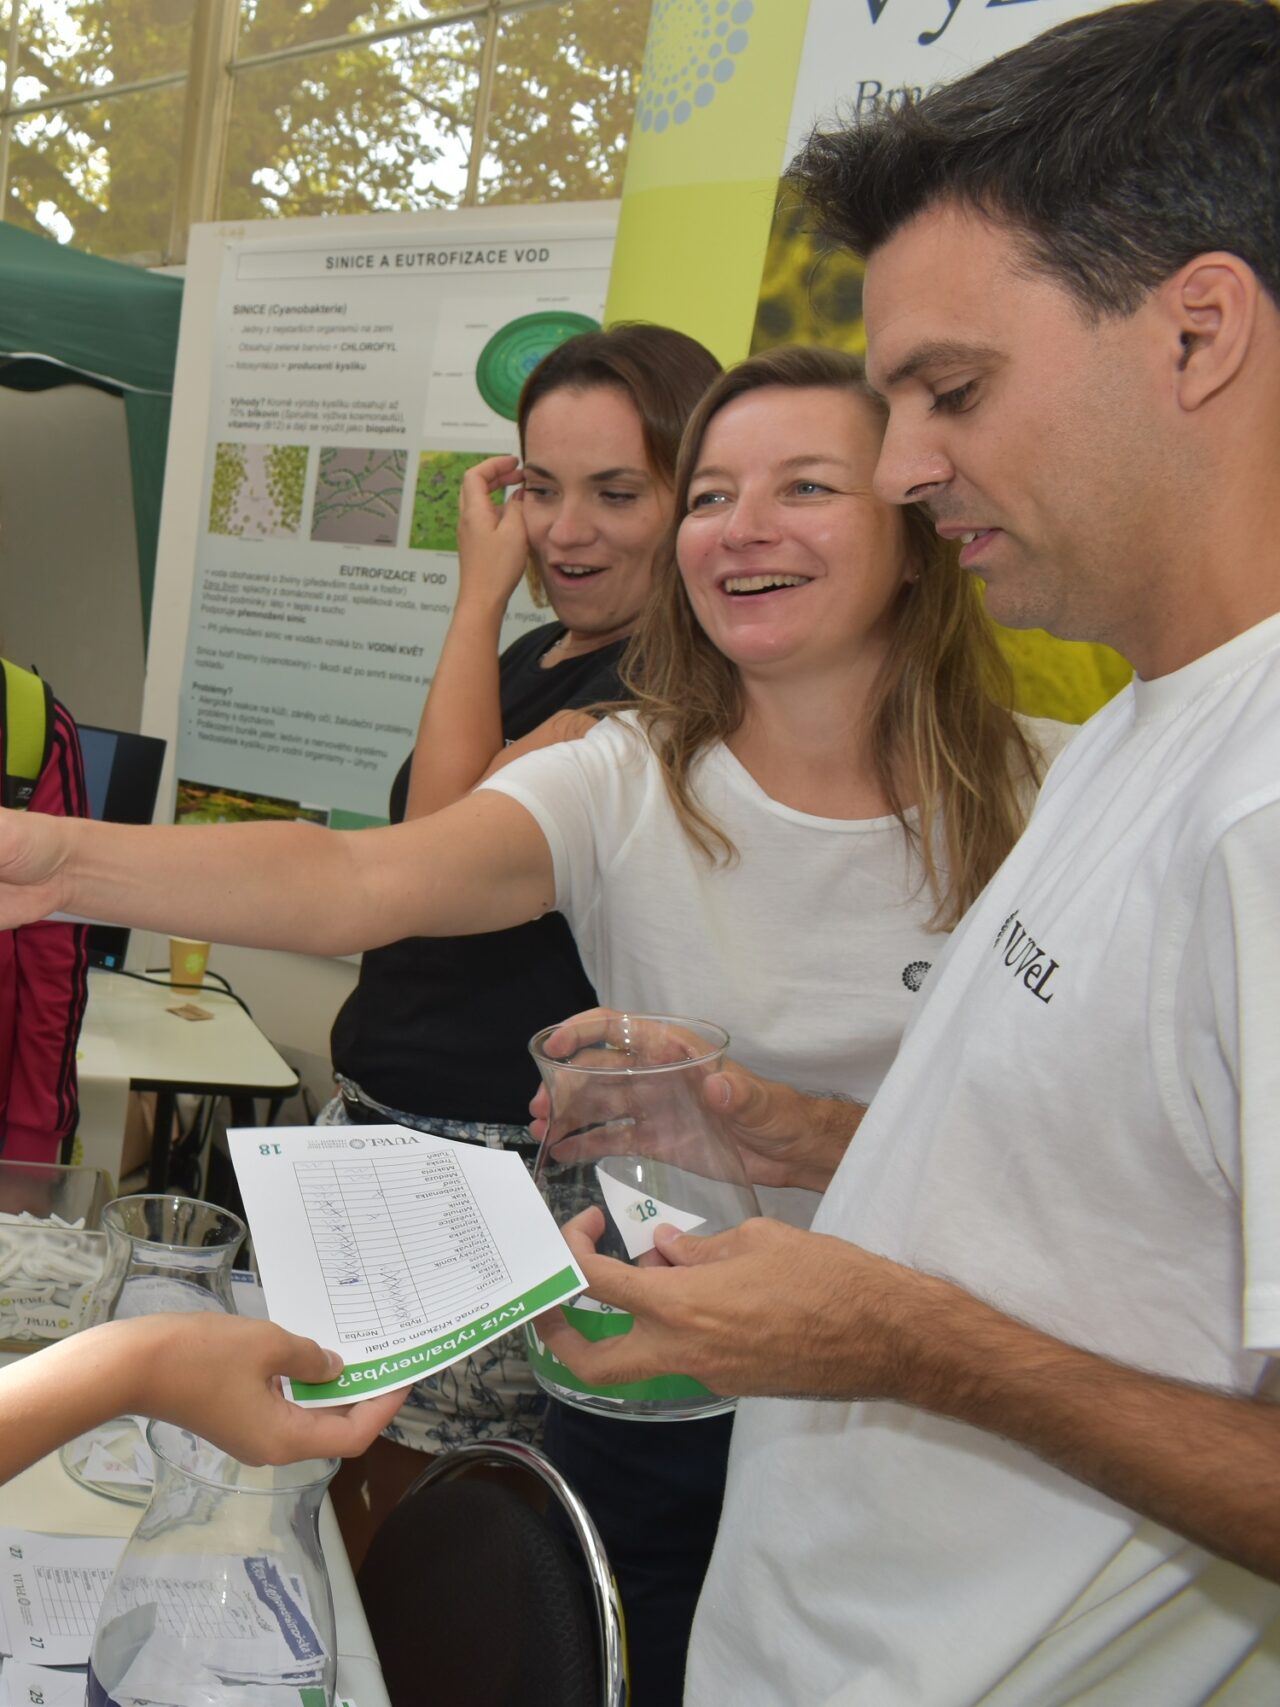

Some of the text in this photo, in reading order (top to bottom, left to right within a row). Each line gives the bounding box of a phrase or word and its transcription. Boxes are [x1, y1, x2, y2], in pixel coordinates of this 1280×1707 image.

[325, 248, 550, 269] SINICE A EUTROFIZACE VOD
[233, 303, 347, 317] SINICE (Cyanobakterie)
[341, 341, 397, 352] CHLOROFYL
[339, 564, 448, 586] EUTROFIZACE VOD
[368, 641, 397, 654] VODNÍ
[258, 1144, 282, 1156] 18
[426, 1158, 452, 1167] Treska
[421, 1165, 455, 1175] Makrela
[415, 1186, 464, 1199] Hřebenatka
[635, 1199, 658, 1222] 18
[449, 1226, 482, 1239] Kosatka
[455, 1303, 490, 1324] Označ
[480, 1301, 526, 1330] Kvíz
[399, 1318, 422, 1329] Ryba
[344, 1330, 379, 1341] Neryba
[408, 1319, 454, 1342] křížkem
[391, 1336, 407, 1346] co
[336, 1327, 477, 1387] ryba/neryba?
[29, 1636, 45, 1650] 27
[29, 1690, 45, 1705] 29
